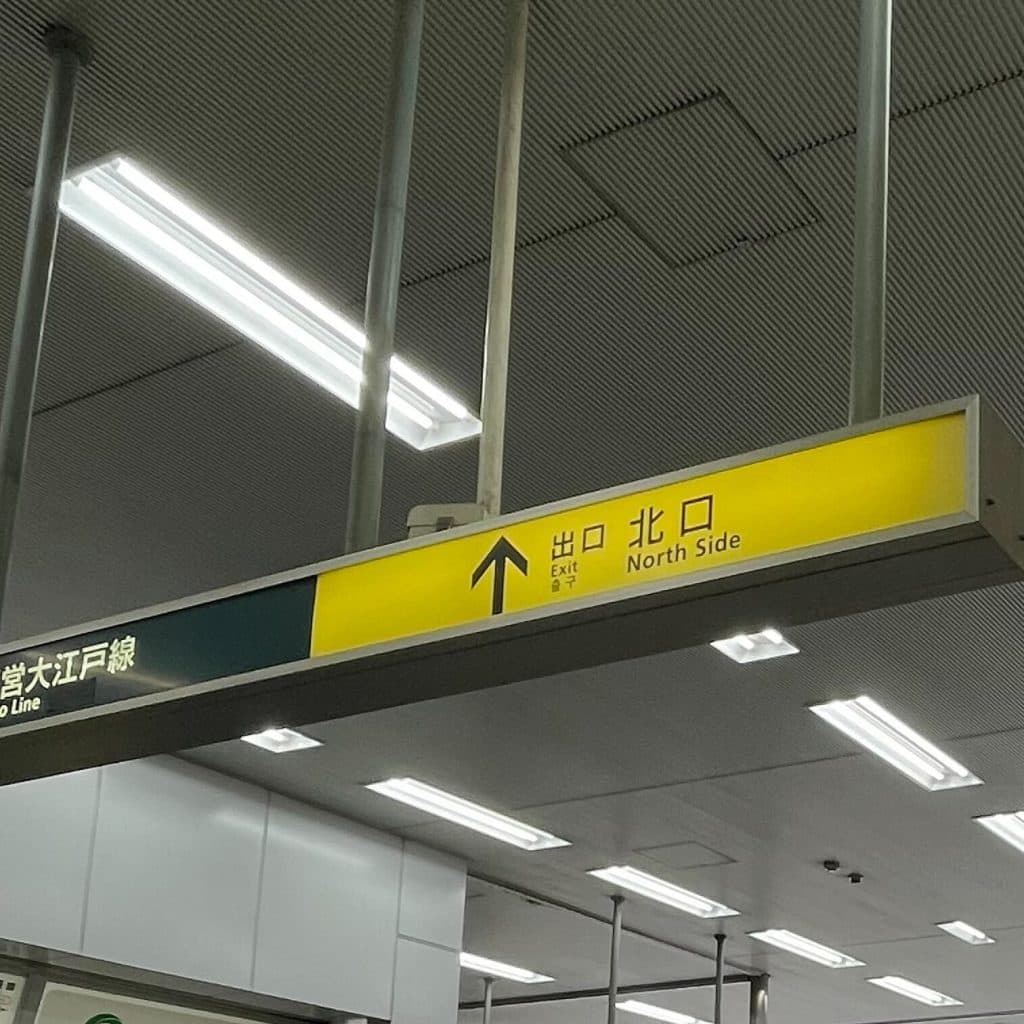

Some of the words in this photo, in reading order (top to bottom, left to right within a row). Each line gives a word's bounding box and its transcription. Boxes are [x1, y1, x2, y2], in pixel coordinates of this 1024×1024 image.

[551, 523, 605, 561] 出口
[628, 494, 714, 549] 北口
[626, 543, 687, 573] North
[695, 531, 741, 557] Side
[551, 561, 577, 578] Exit
[11, 696, 41, 715] Line
